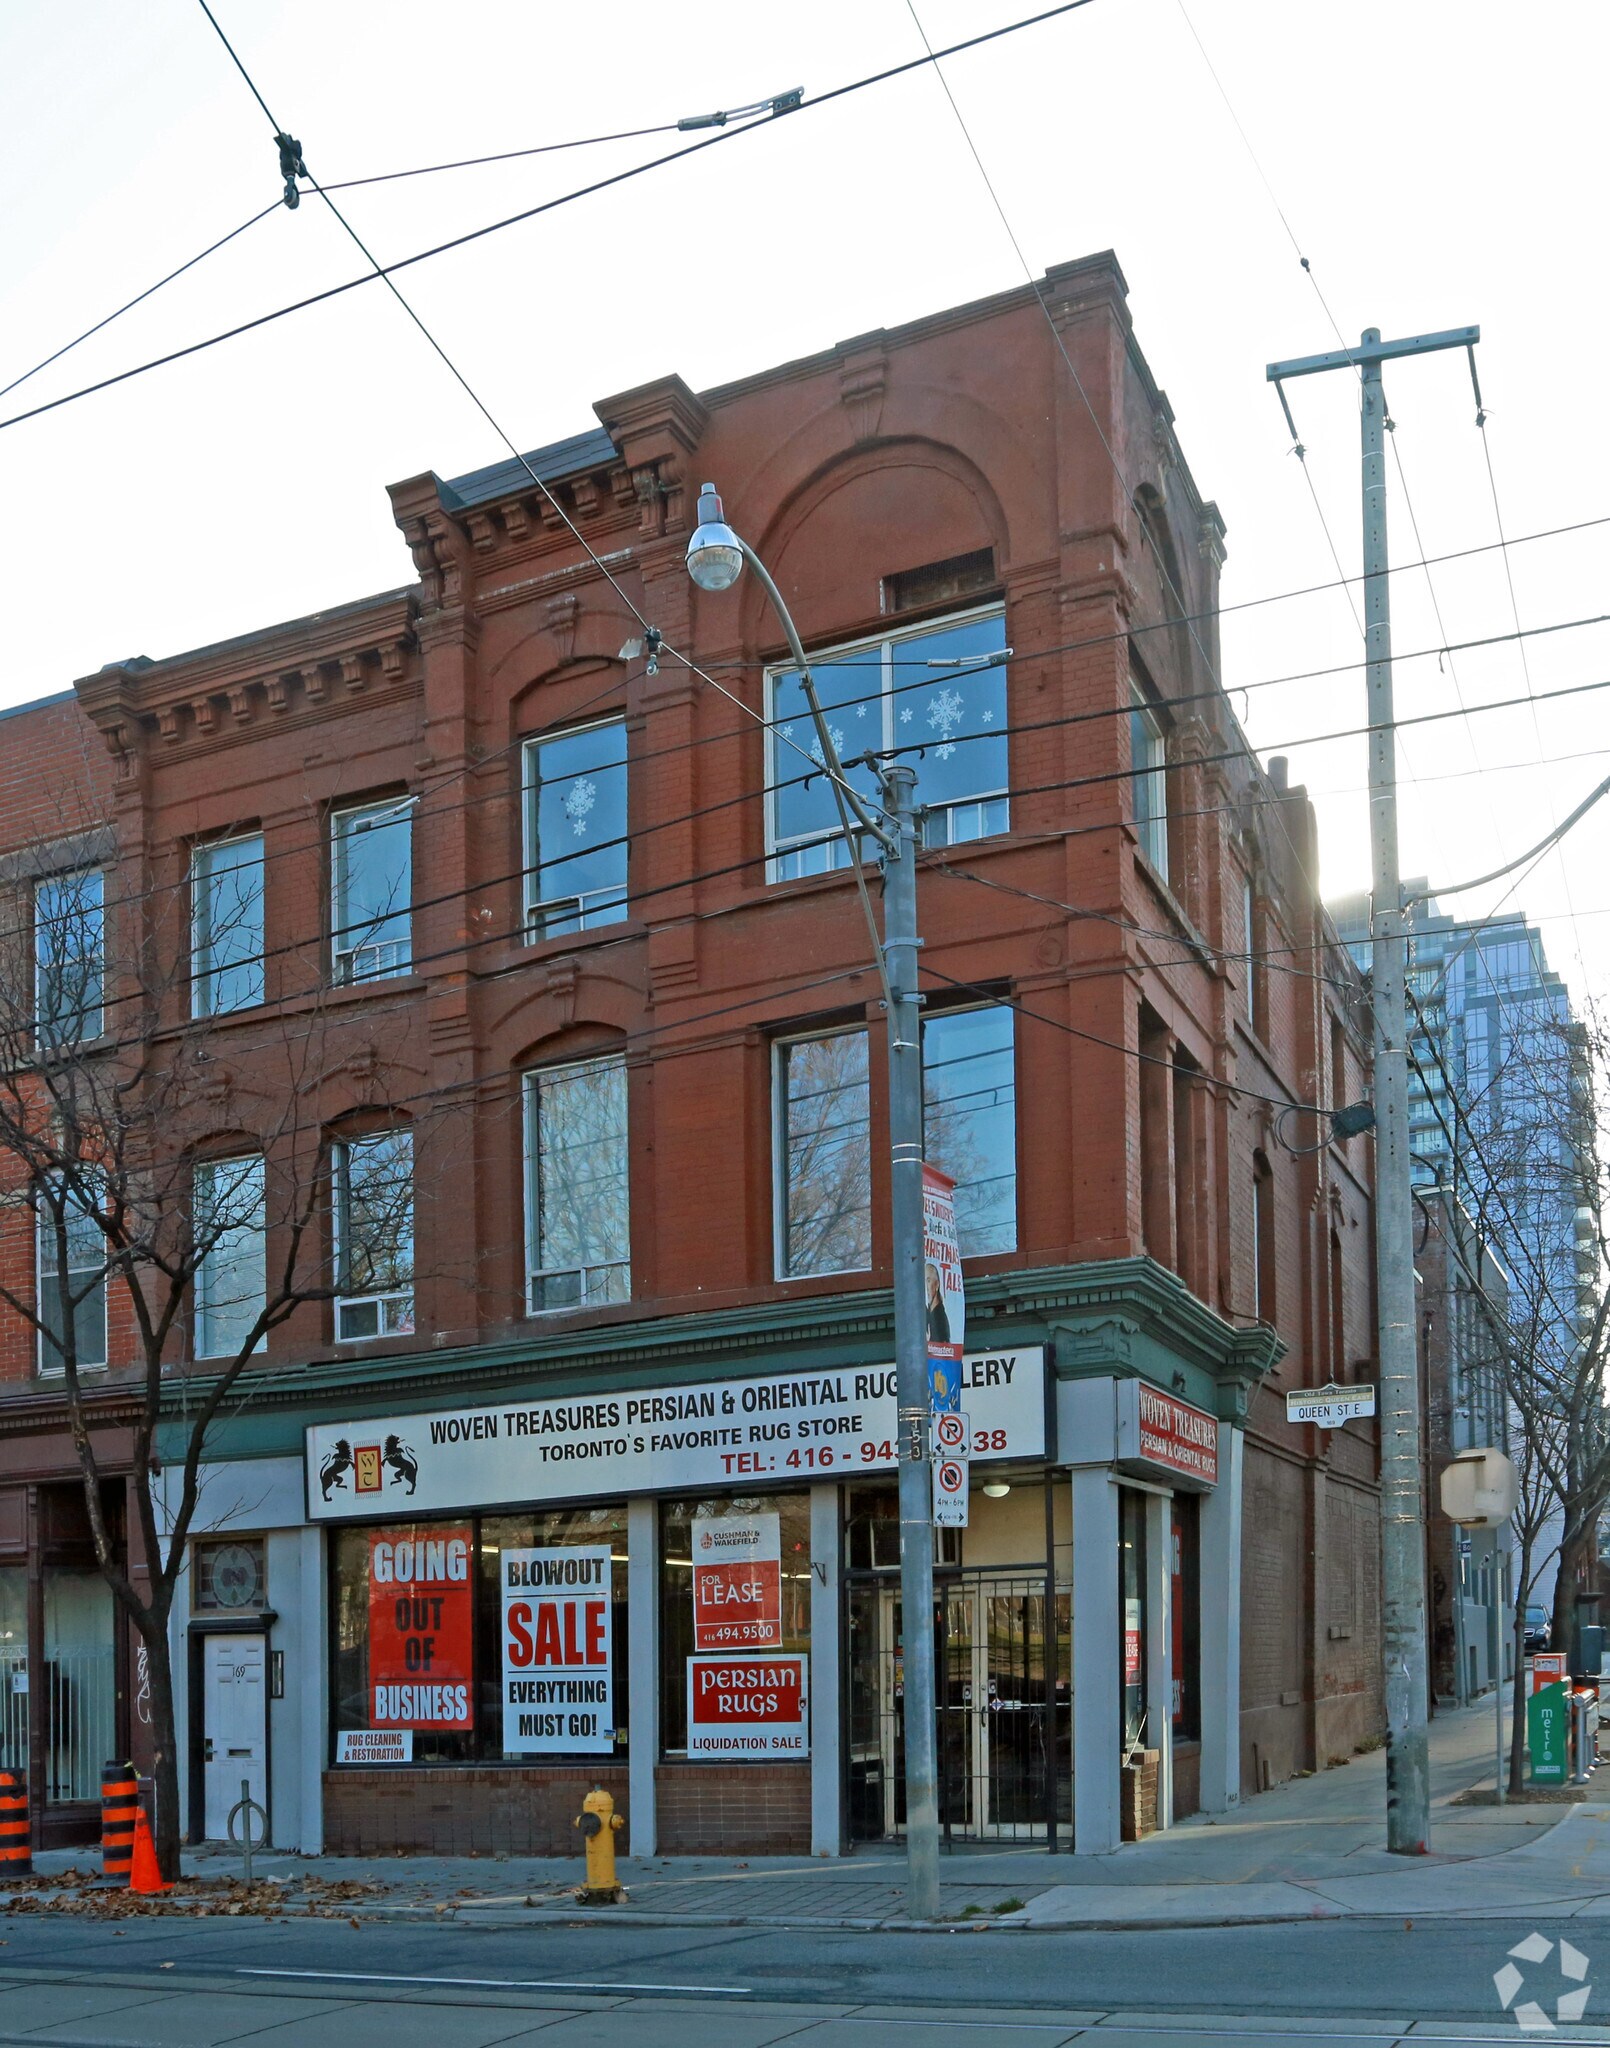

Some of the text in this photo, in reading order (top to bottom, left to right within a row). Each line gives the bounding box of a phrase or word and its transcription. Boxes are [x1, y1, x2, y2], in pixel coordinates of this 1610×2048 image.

[430, 1414, 498, 1445] WOVEN
[504, 1402, 620, 1436] TREASURES
[627, 1392, 714, 1424] PERSIAN
[721, 1390, 735, 1415] &
[742, 1377, 848, 1412] ORIENTAL
[855, 1371, 898, 1400] RUG
[1298, 1403, 1363, 1419] QUEEN ST. E.
[1140, 1391, 1216, 1452] WOVEN TREASURES
[540, 1415, 862, 1463] TORONTO'S FAVORITE RUG STORE
[1140, 1430, 1167, 1455] PERSIAN
[1174, 1443, 1202, 1469] ORIENTAL
[720, 1451, 775, 1474] TEL:
[786, 1446, 834, 1468] 416
[713, 1530, 754, 1539] CUSHMAN
[714, 1537, 759, 1547] WAKEFIELD
[373, 1539, 468, 1584] GOING
[507, 1558, 604, 1587] BLOWOUT
[701, 1575, 721, 1586] FOR
[702, 1582, 764, 1606] LEASE
[395, 1597, 445, 1631] OUT
[507, 1600, 607, 1668] SALE
[716, 1625, 774, 1641] 494.9500
[405, 1636, 435, 1673] OF
[232, 1665, 246, 1678] 169
[375, 1685, 467, 1721] BUSINESS
[508, 1680, 608, 1704] EVERYTHING
[519, 1713, 597, 1737] MUST GO!
[347, 1733, 402, 1747] RUG CLEANING
[693, 1737, 802, 1751] LIQUIDATION SALE
[344, 1748, 405, 1761] & RESTORATION
